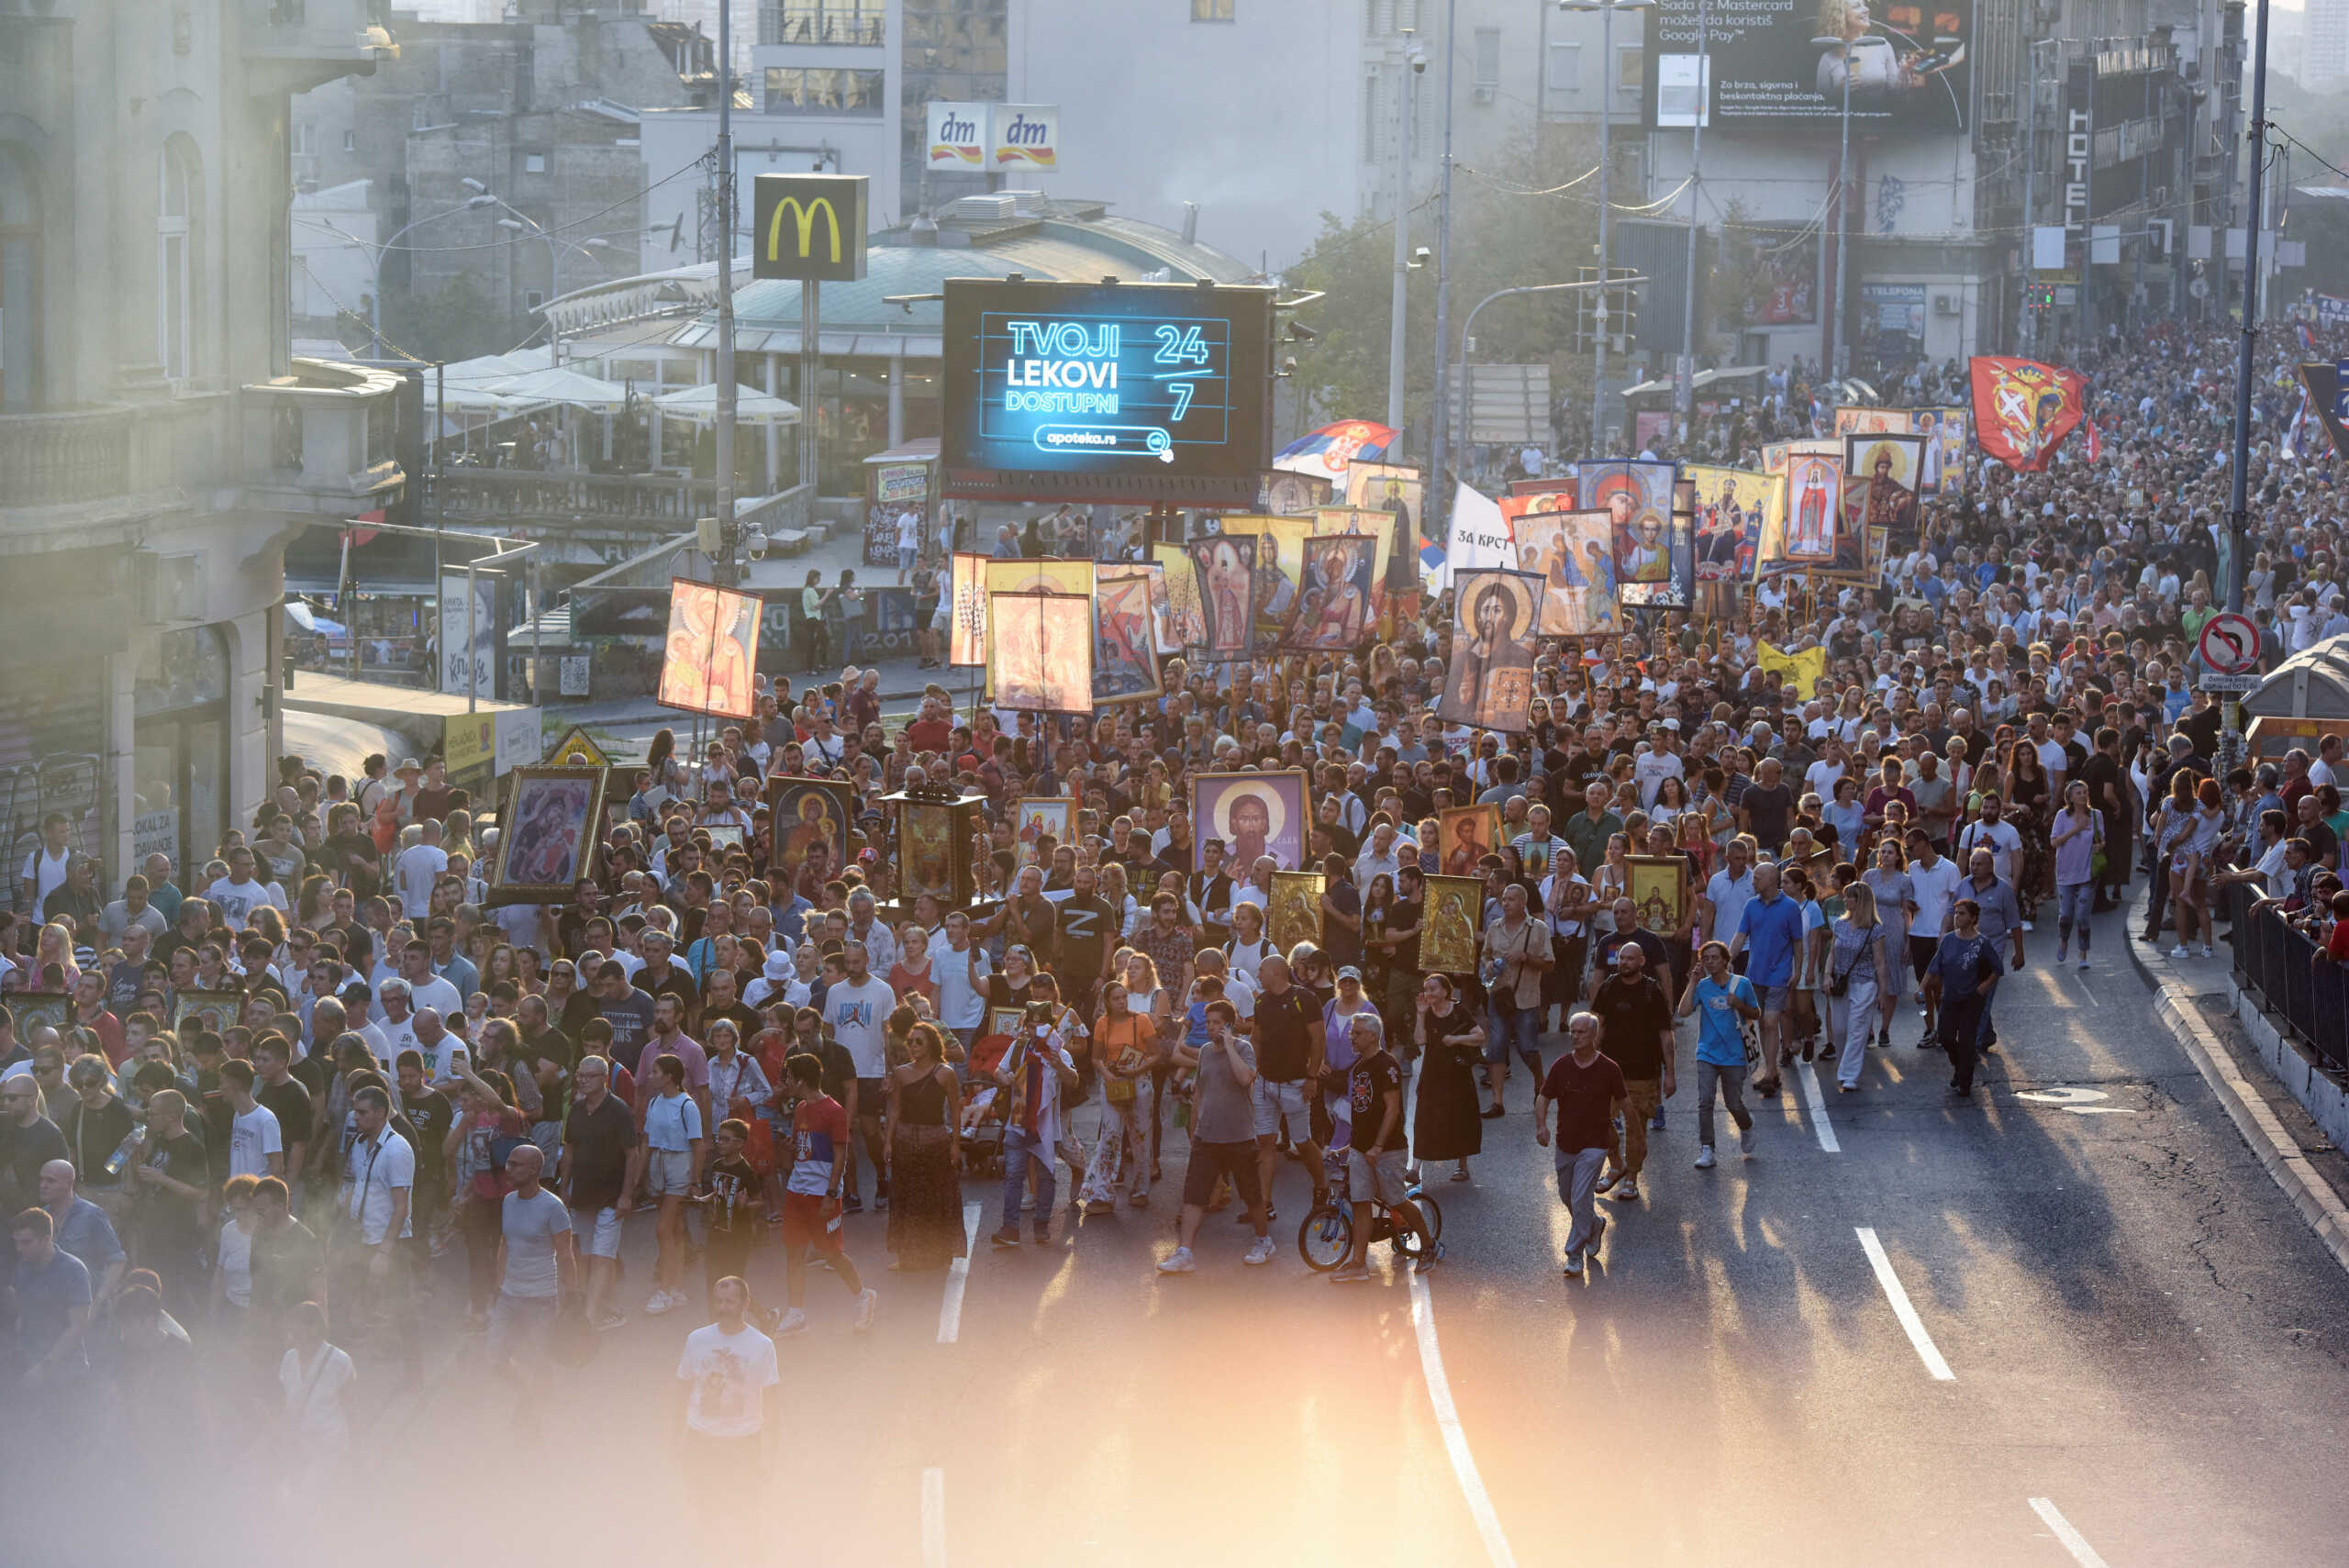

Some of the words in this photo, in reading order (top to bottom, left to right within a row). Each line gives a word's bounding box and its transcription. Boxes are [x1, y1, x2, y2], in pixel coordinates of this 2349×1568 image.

[1659, 0, 1695, 11] Sada
[1717, 0, 1794, 11] Mastercard
[1705, 14, 1723, 27] da
[1725, 14, 1773, 27] koristiš
[1720, 80, 1732, 89] Za
[1759, 80, 1793, 91] sigurna
[1720, 92, 1782, 101] beskontaktna
[940, 112, 975, 143] dm
[1007, 114, 1047, 145] dm
[2065, 108, 2088, 229] HOTEL
[1871, 285, 1924, 296] TELEFONA
[1008, 321, 1119, 359] TVOJI
[1153, 325, 1209, 365] 24
[1007, 359, 1119, 390] LEKOVI
[1006, 390, 1119, 415] DOSTUPNI
[1168, 383, 1195, 421] 7
[1047, 432, 1117, 448] apoteka.rs
[133, 816, 157, 836] OKAL
[160, 814, 171, 829] ZA
